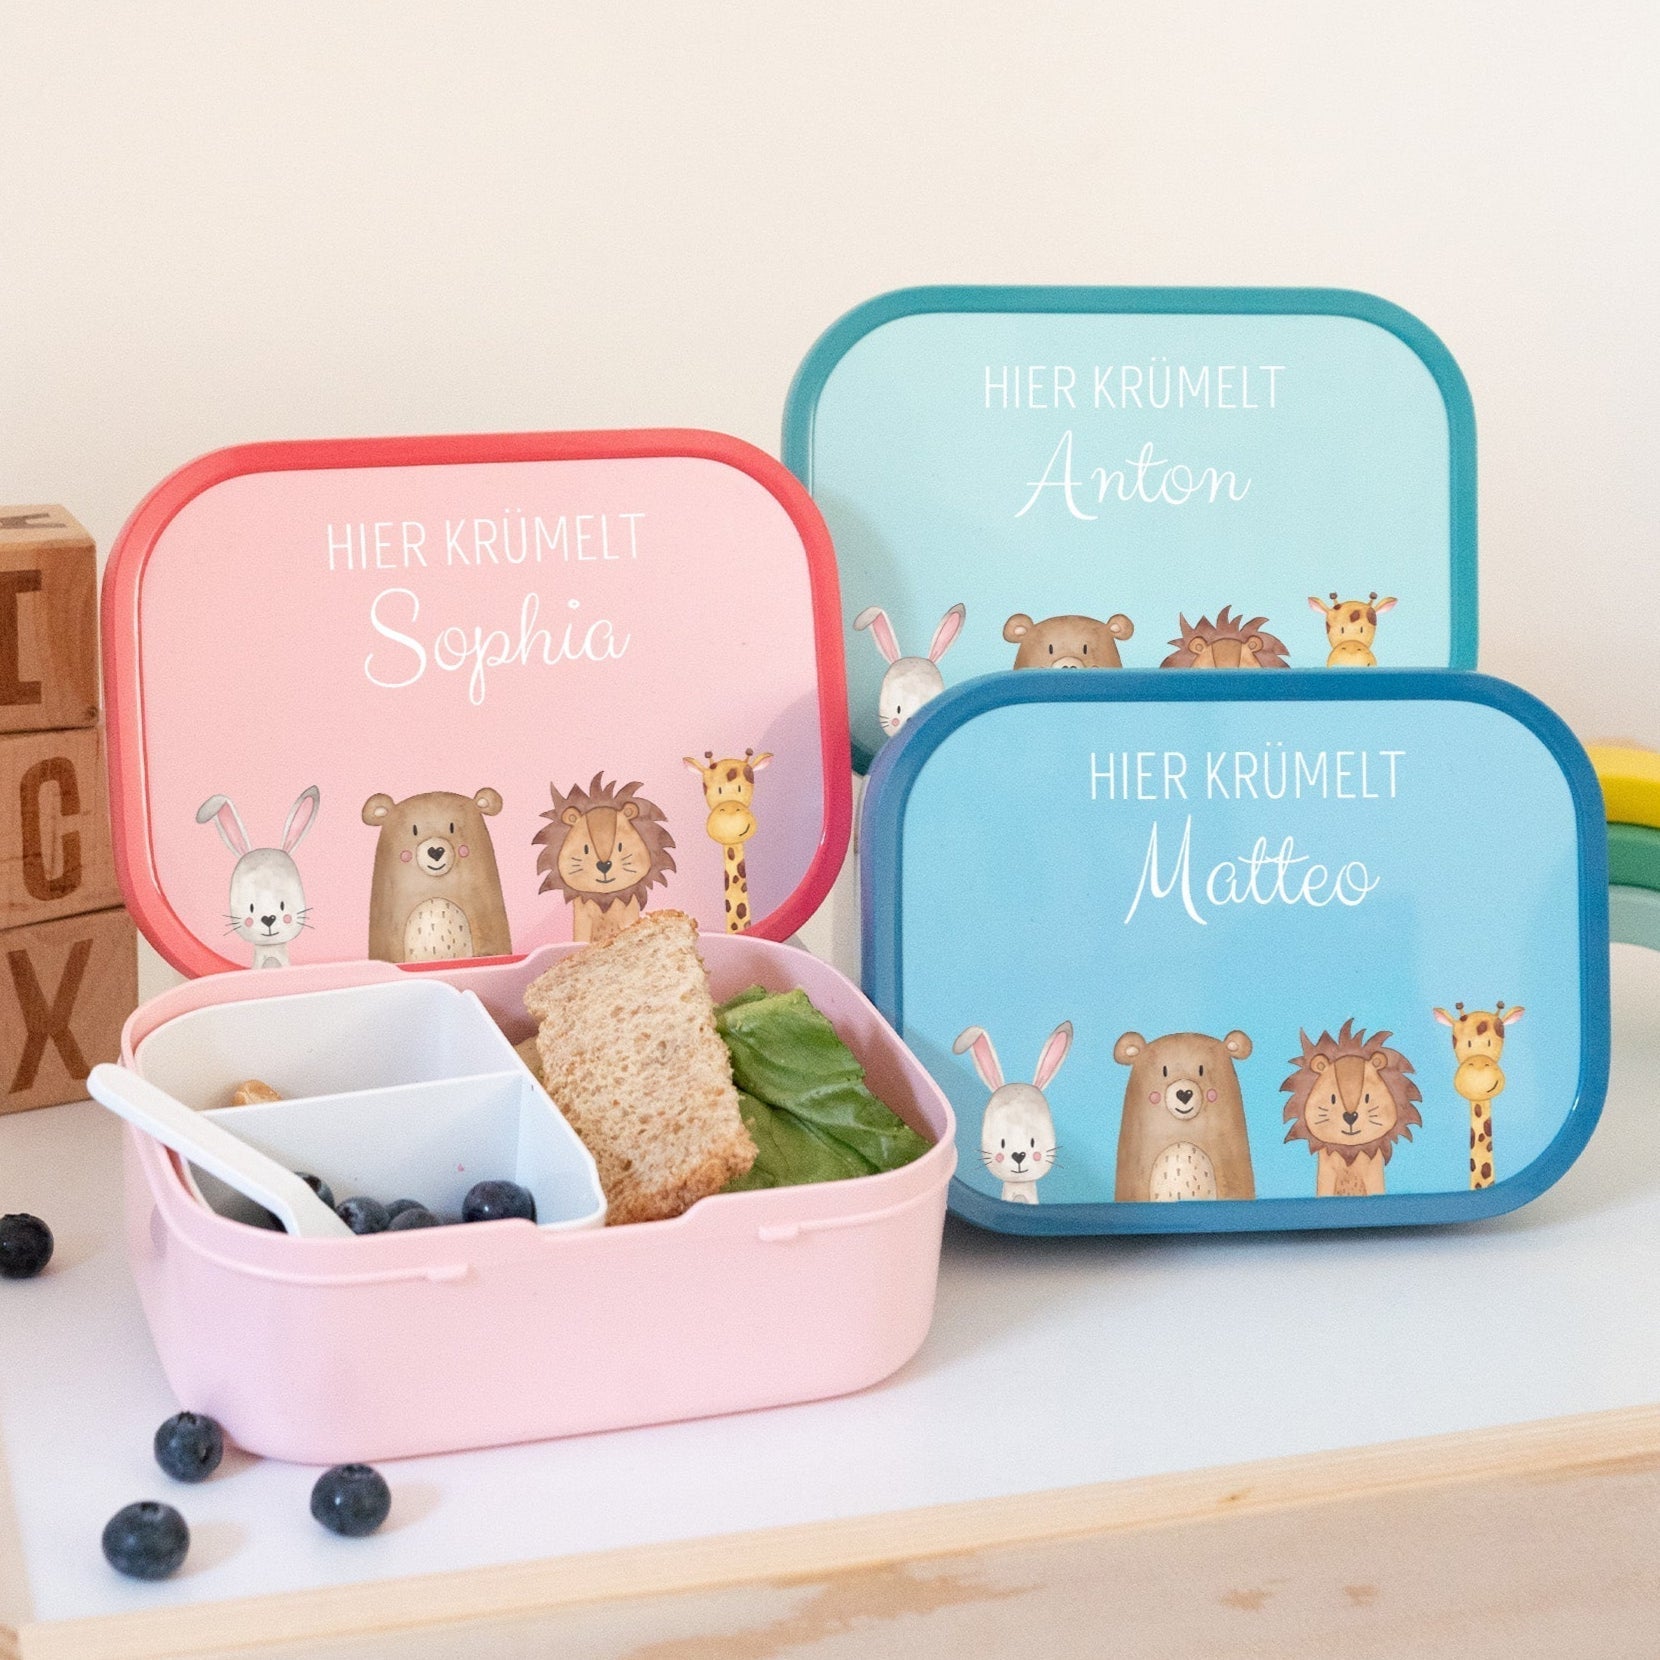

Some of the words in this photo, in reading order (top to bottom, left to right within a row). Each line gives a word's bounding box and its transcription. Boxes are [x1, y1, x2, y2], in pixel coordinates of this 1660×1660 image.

[984, 365, 1077, 409] HIER
[1093, 356, 1287, 409] KRÜMELT
[1013, 429, 1252, 521] Anton
[326, 521, 428, 571] HIER
[445, 507, 647, 566] KRÜMELT
[364, 587, 632, 706] Sophia
[1089, 751, 1188, 800] HIER
[1206, 741, 1407, 800] KRÜMELT
[19, 756, 83, 901] C
[1123, 813, 1382, 926] Matteo
[8, 938, 94, 1095] X
